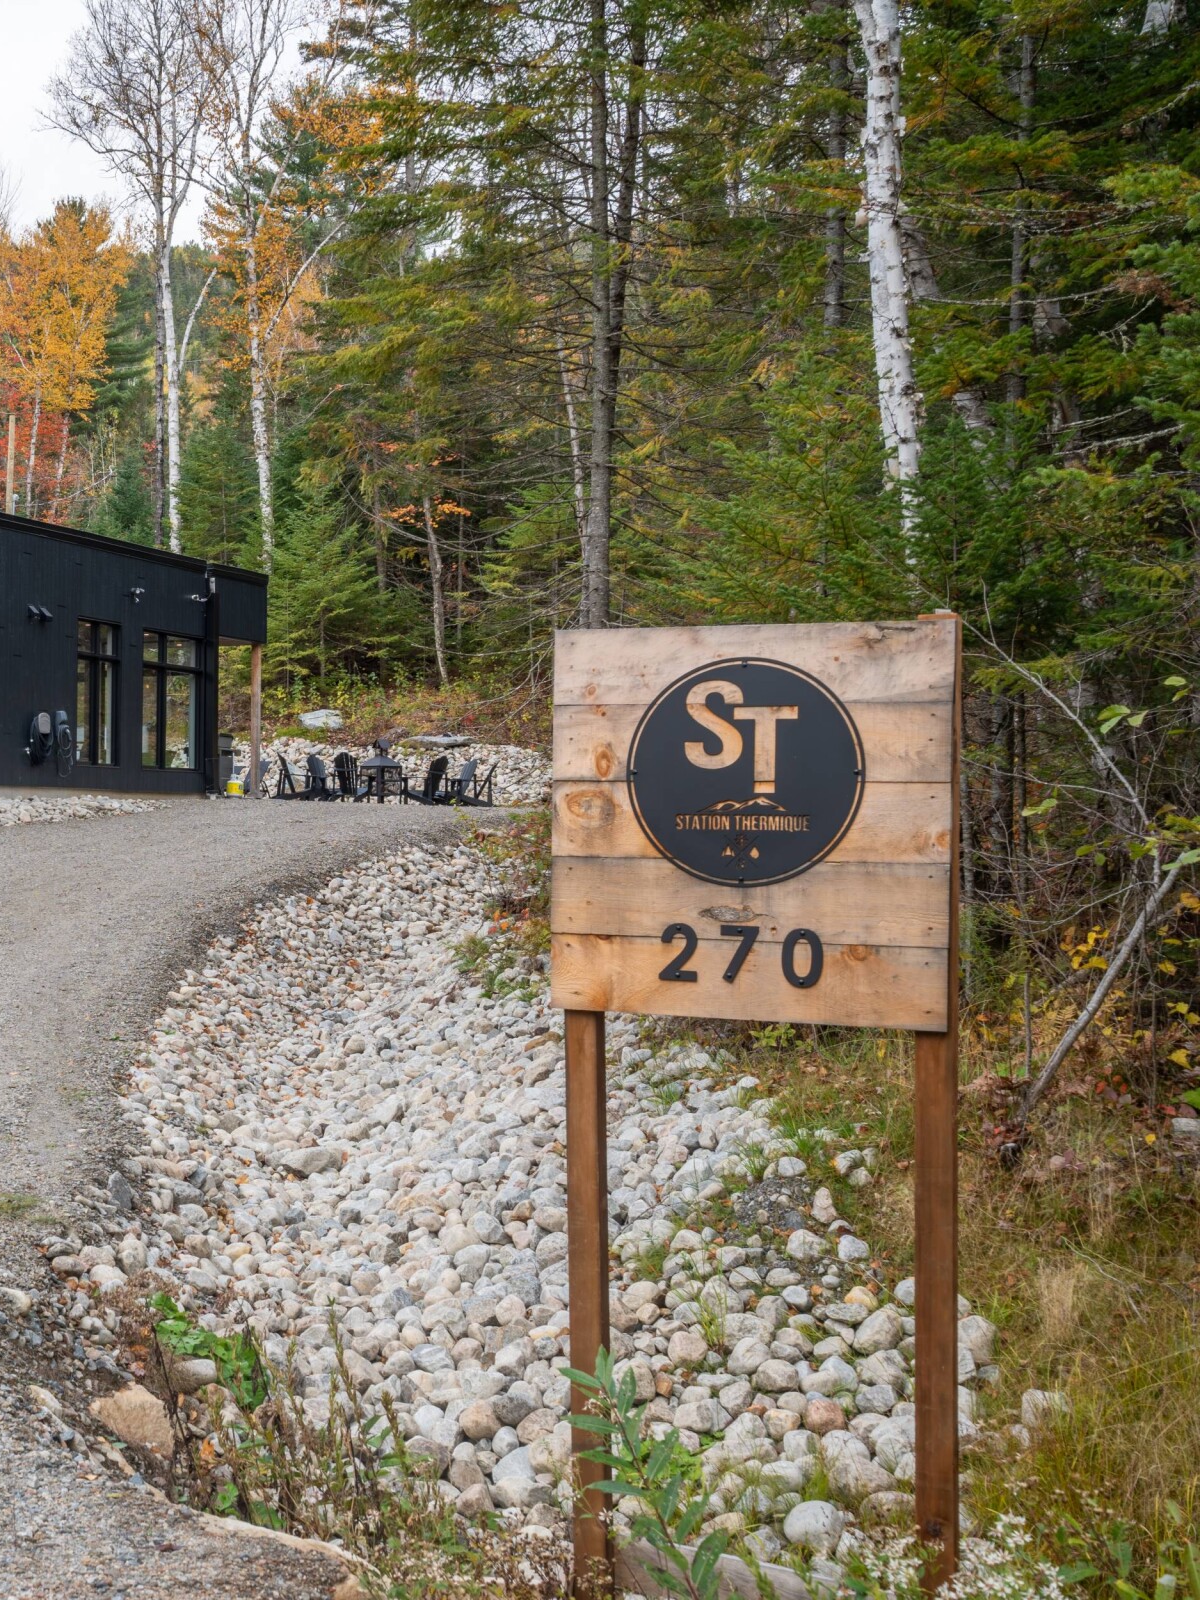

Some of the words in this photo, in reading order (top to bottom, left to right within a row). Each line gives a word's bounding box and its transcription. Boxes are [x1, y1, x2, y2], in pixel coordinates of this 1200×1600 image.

[684, 680, 798, 794] ST
[675, 814, 730, 831] STATION
[734, 814, 810, 832] THERMIQUE
[658, 922, 824, 988] 270
